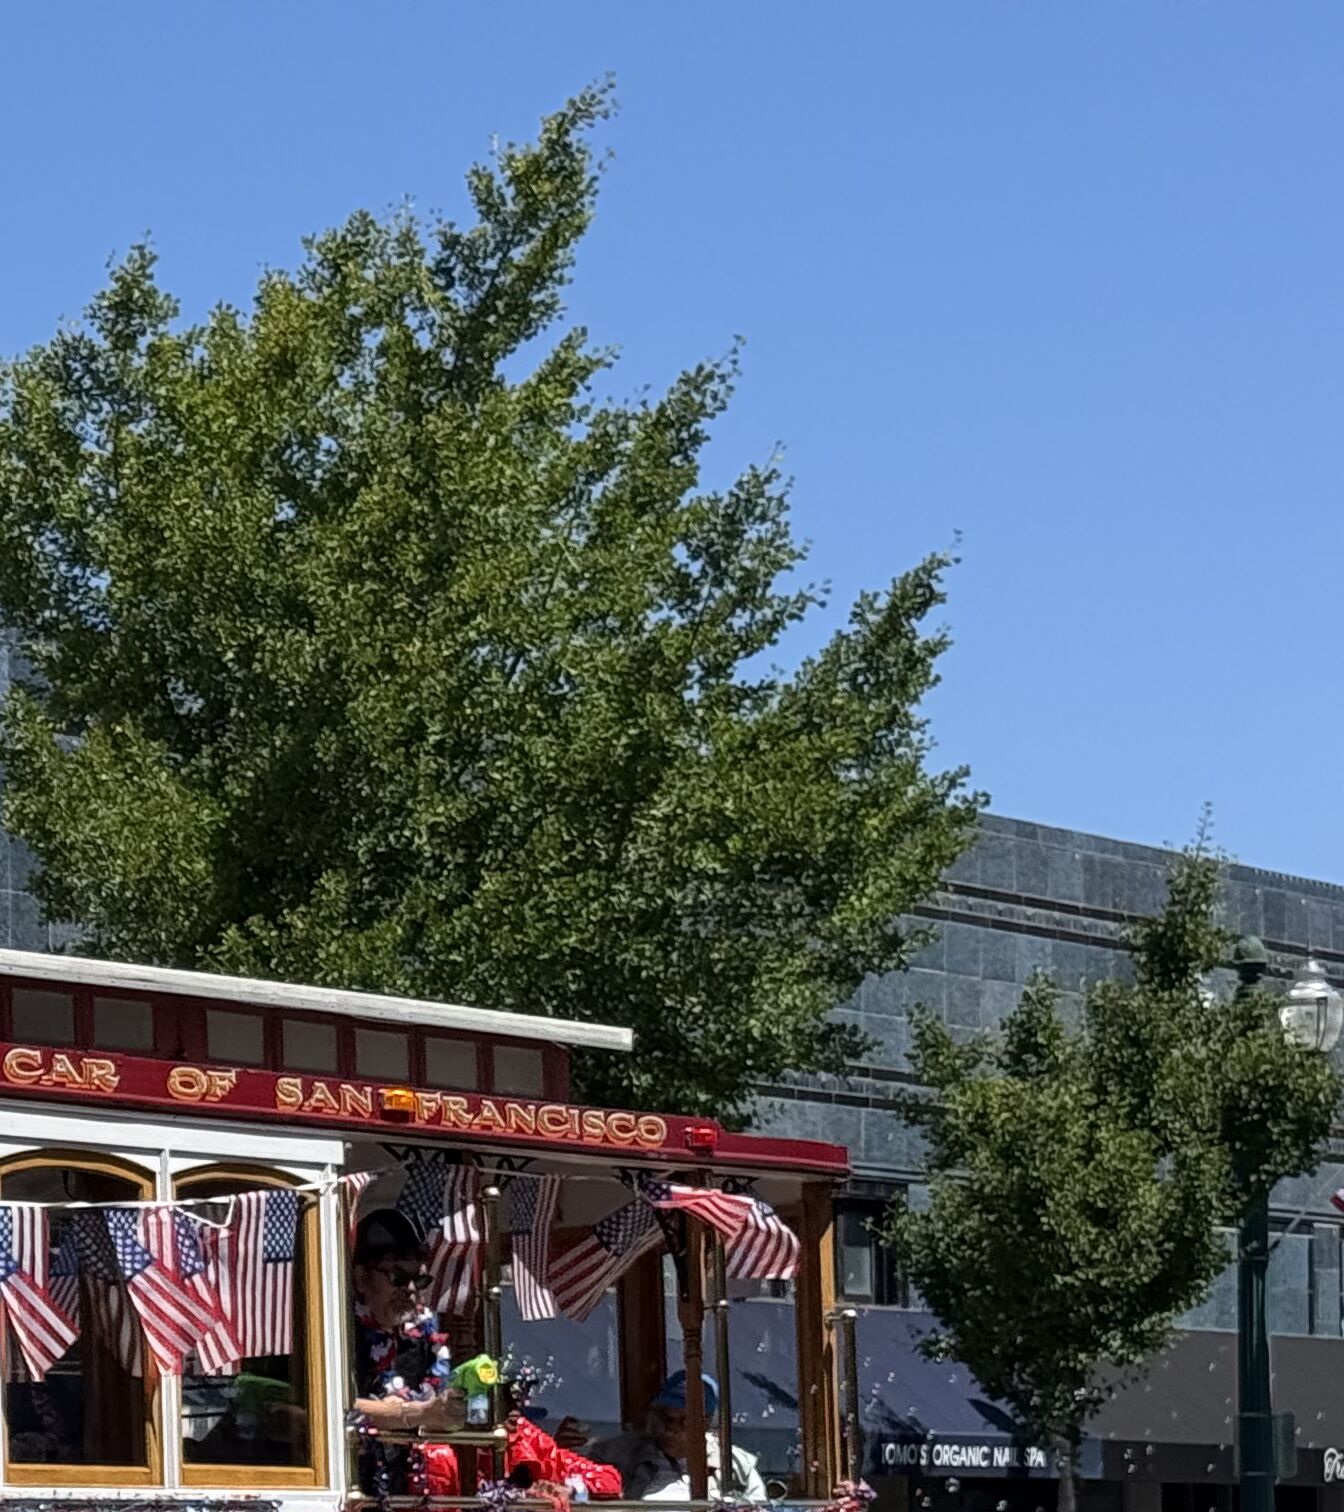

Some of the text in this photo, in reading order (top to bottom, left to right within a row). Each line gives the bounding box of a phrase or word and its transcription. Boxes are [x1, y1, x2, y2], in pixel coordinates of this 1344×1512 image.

[3, 1047, 120, 1092] CAR
[166, 1066, 237, 1102] OF
[275, 1076, 376, 1120] SAN
[413, 1088, 668, 1149] FRANCISCO
[932, 1443, 990, 1467] ORGANIC
[1023, 1446, 1047, 1467] SPA
